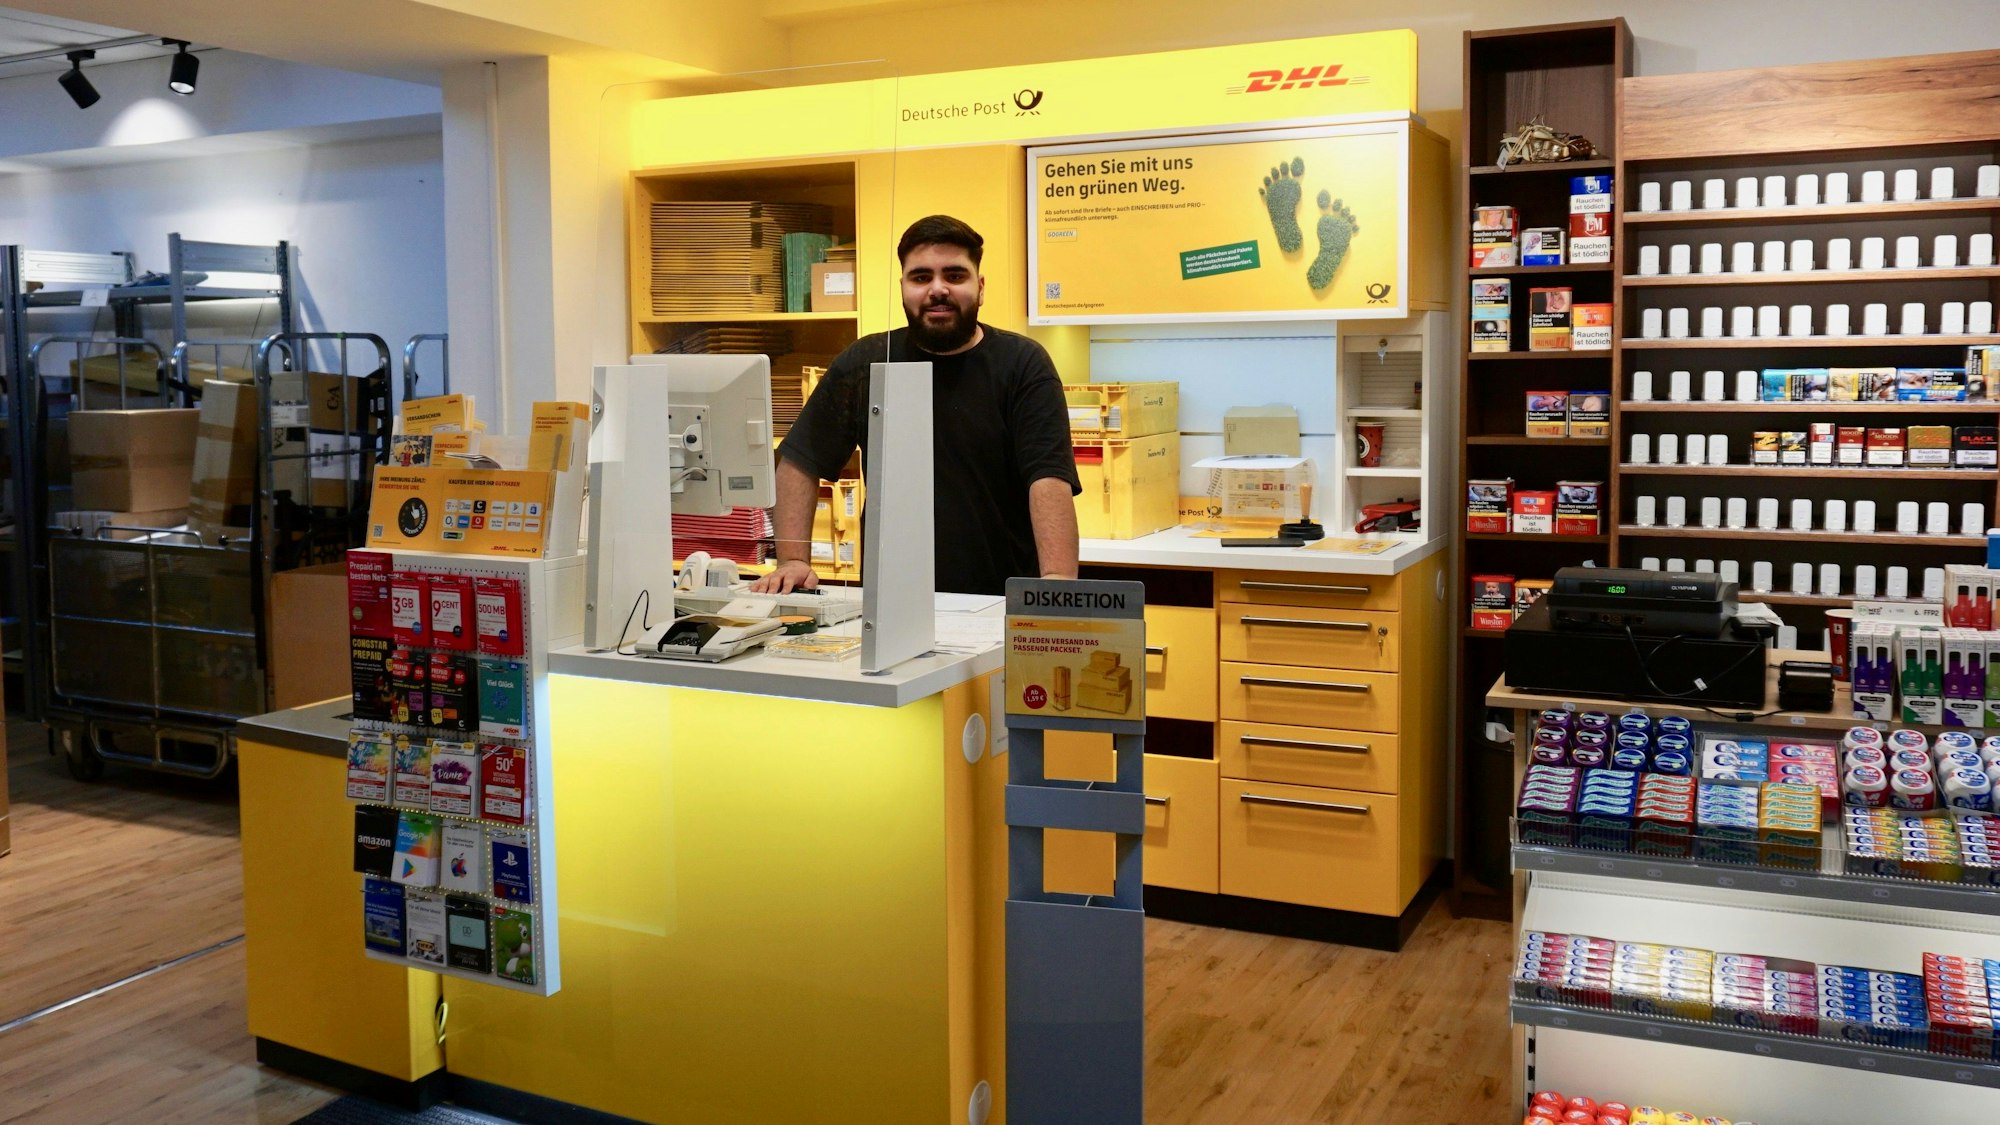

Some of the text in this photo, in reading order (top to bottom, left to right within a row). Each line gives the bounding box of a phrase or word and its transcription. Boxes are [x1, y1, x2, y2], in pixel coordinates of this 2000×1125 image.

[1245, 64, 1351, 93] DHL
[902, 101, 1006, 122] Deutsche Post
[1045, 157, 1193, 178] Gehen Sie mit uns
[1045, 178, 1185, 199] den grünen Weg.
[1131, 203, 1174, 211] EINSCHREIBEN
[1045, 213, 1087, 223] klimafreundlich
[350, 562, 381, 571] Prepaid im
[350, 572, 387, 581] besten Netz
[393, 597, 413, 613] 3 GB
[1024, 590, 1125, 609] DISKRETION
[433, 601, 459, 617] 9 CENT
[479, 605, 505, 615] 500 MB
[1480, 617, 1503, 625] Winston
[353, 639, 387, 650] CONGSTAR
[1013, 635, 1027, 643] FÜR
[1051, 638, 1084, 646] VERSAND
[1013, 644, 1082, 654] PASSENDE PACKSET.
[353, 650, 382, 660] PREPAID
[498, 680, 514, 688] Glück
[438, 769, 462, 780] Danke
[357, 834, 391, 847] amazon
[399, 831, 416, 841] Google
